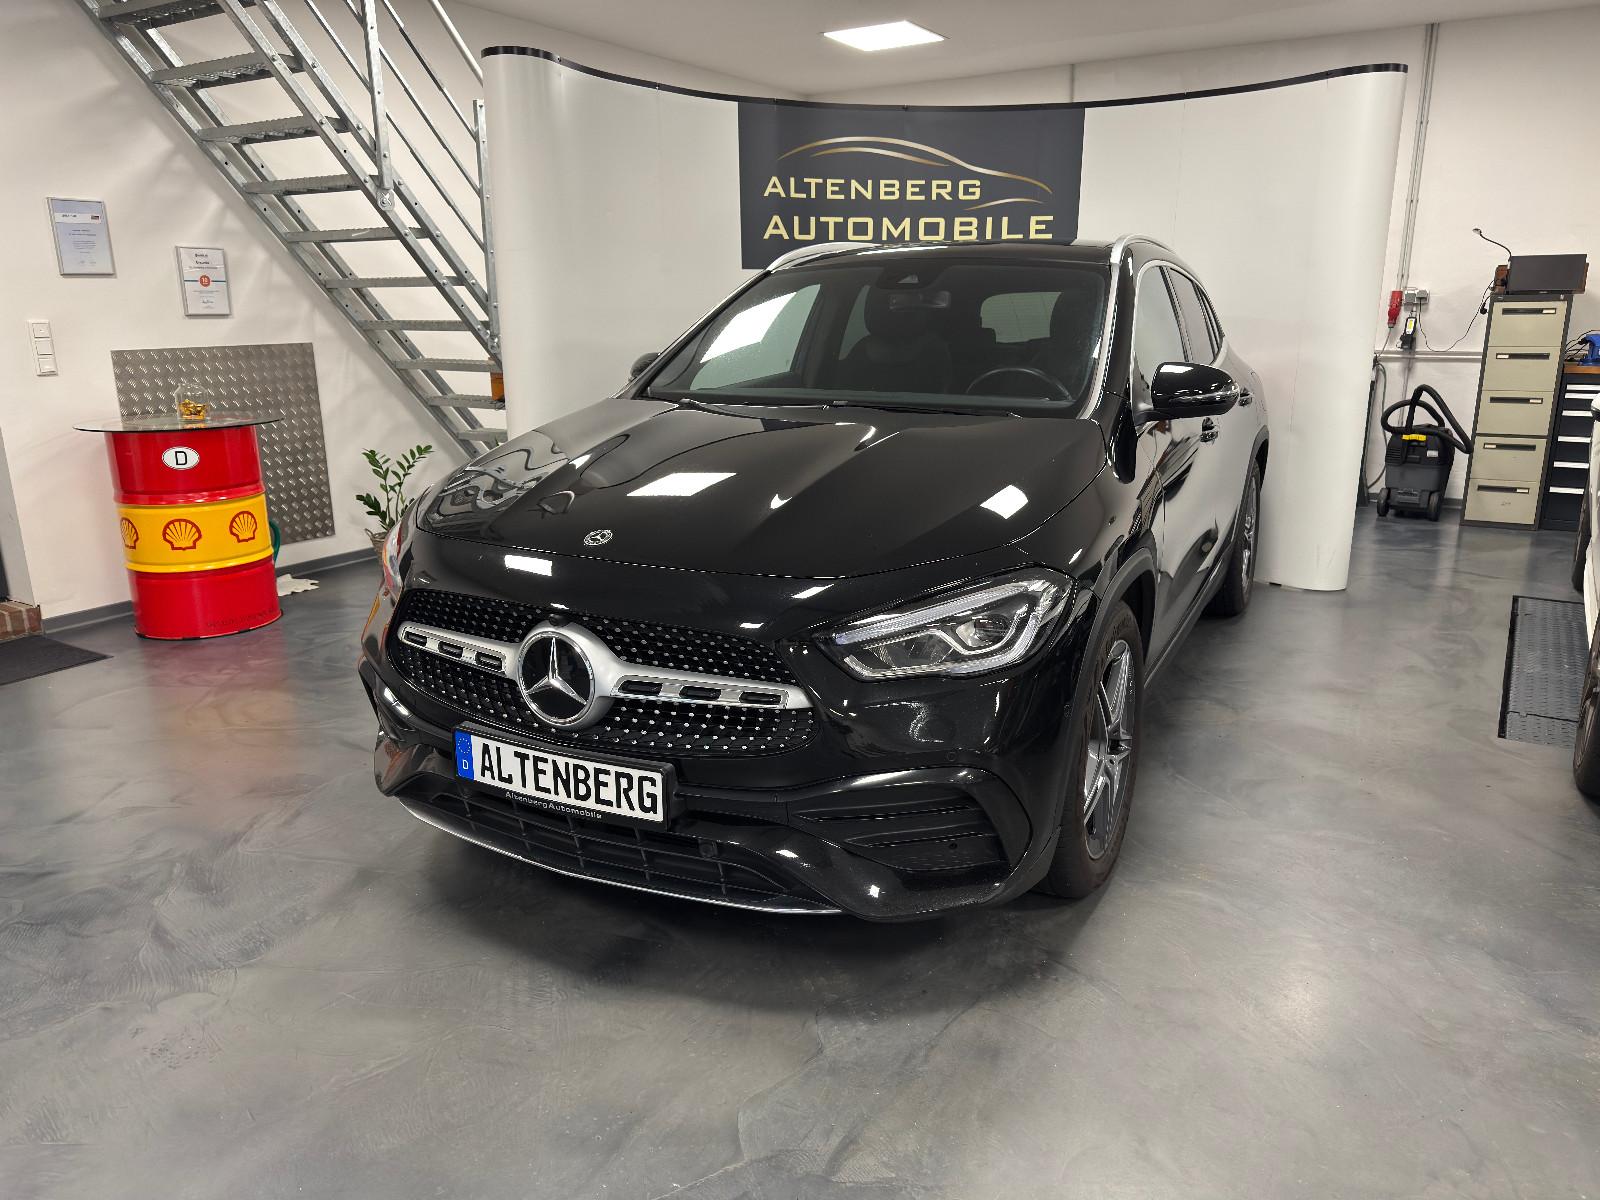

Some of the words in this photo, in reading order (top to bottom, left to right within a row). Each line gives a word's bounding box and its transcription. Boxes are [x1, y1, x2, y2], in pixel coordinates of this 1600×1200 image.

[763, 176, 981, 200] ALTENBERG
[763, 215, 1054, 241] AUTOMOBILE
[175, 451, 187, 465] D
[462, 760, 469, 770] D
[480, 743, 658, 815] ALTENBERG
